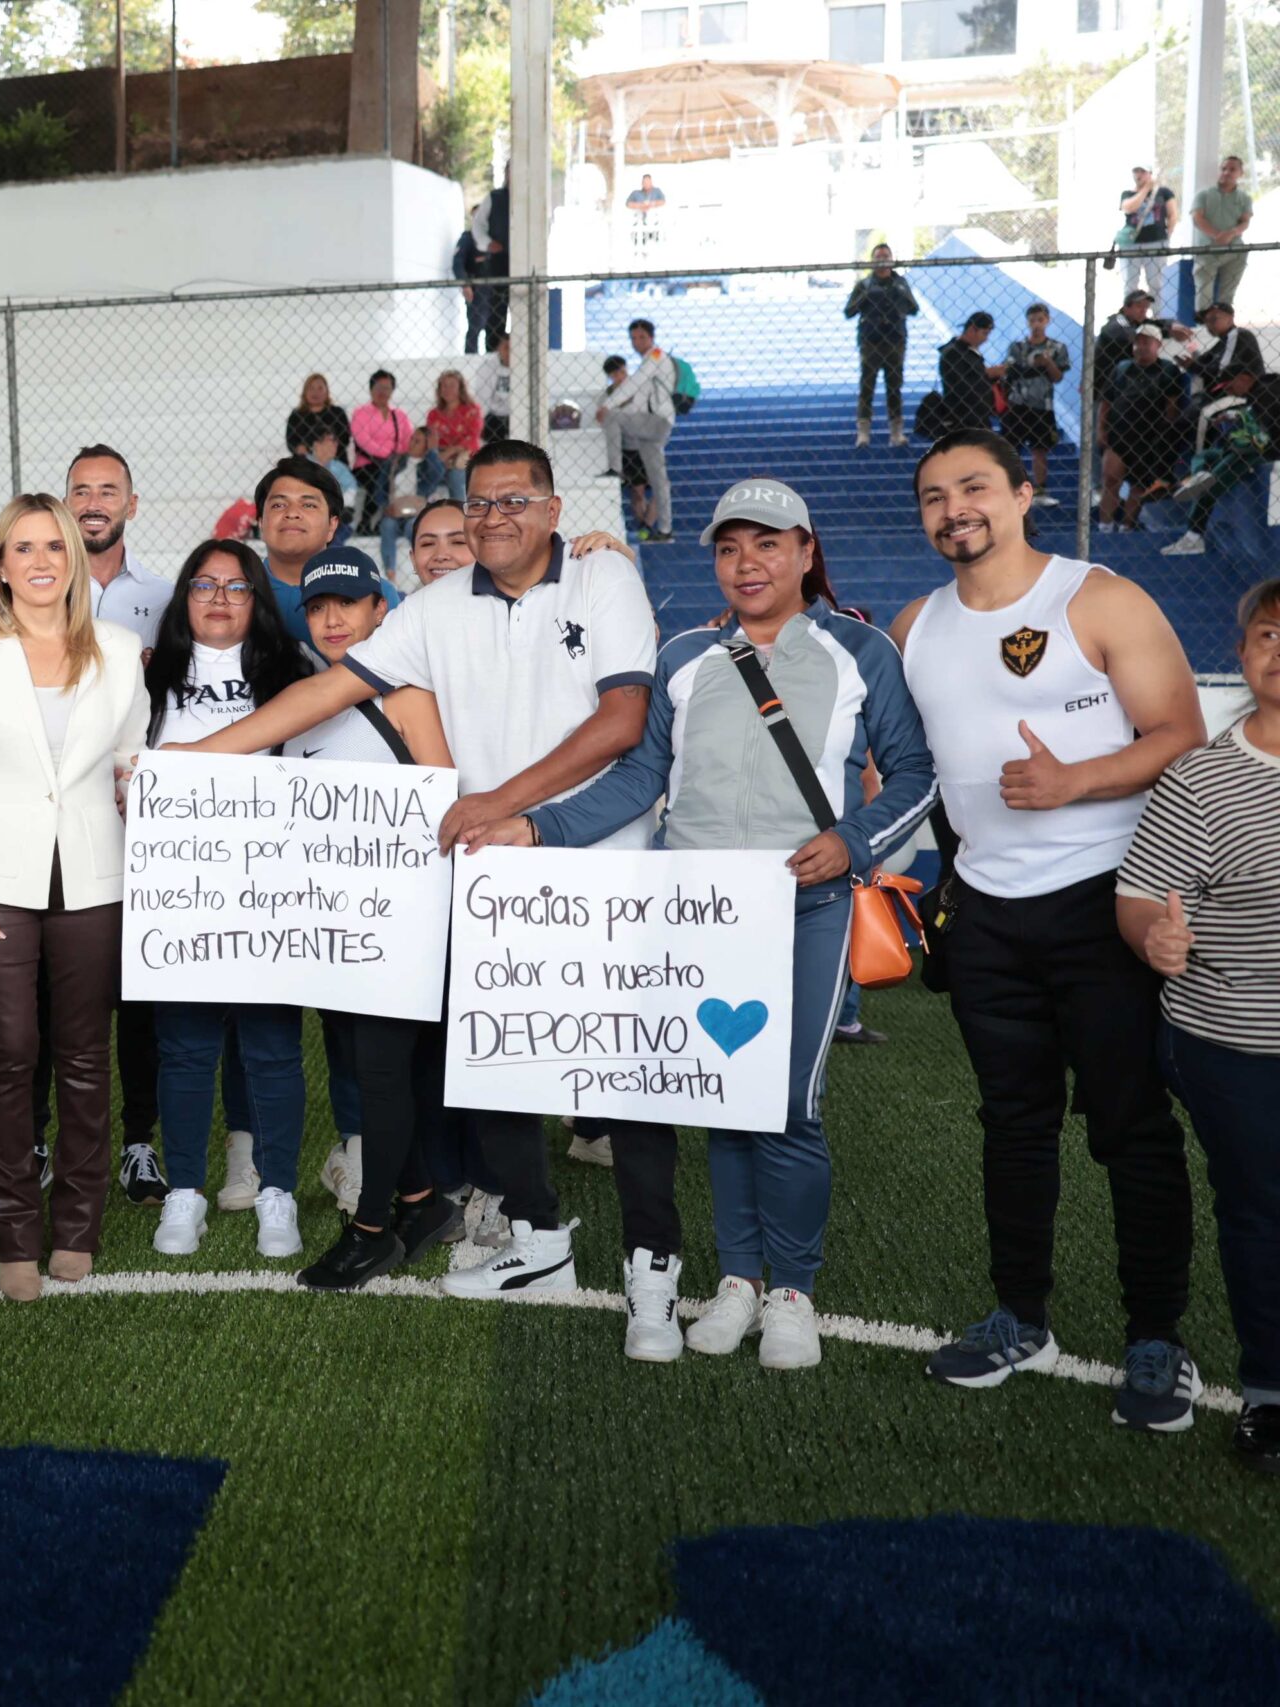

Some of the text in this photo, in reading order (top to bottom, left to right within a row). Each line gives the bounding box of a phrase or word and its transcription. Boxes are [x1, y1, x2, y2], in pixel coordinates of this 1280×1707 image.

[723, 487, 794, 508] ORT
[210, 704, 254, 715] FRANCE
[1065, 692, 1109, 712] ECHT
[132, 769, 276, 820] Presidenta
[130, 833, 438, 875] gracias por rehabilitar
[130, 875, 393, 919] nuestro deportivo de
[466, 874, 739, 942] Gracias por darle
[475, 947, 704, 991] color a nuestro
[459, 1010, 689, 1061] DEPORTIVO
[561, 1058, 725, 1111] presidenta
